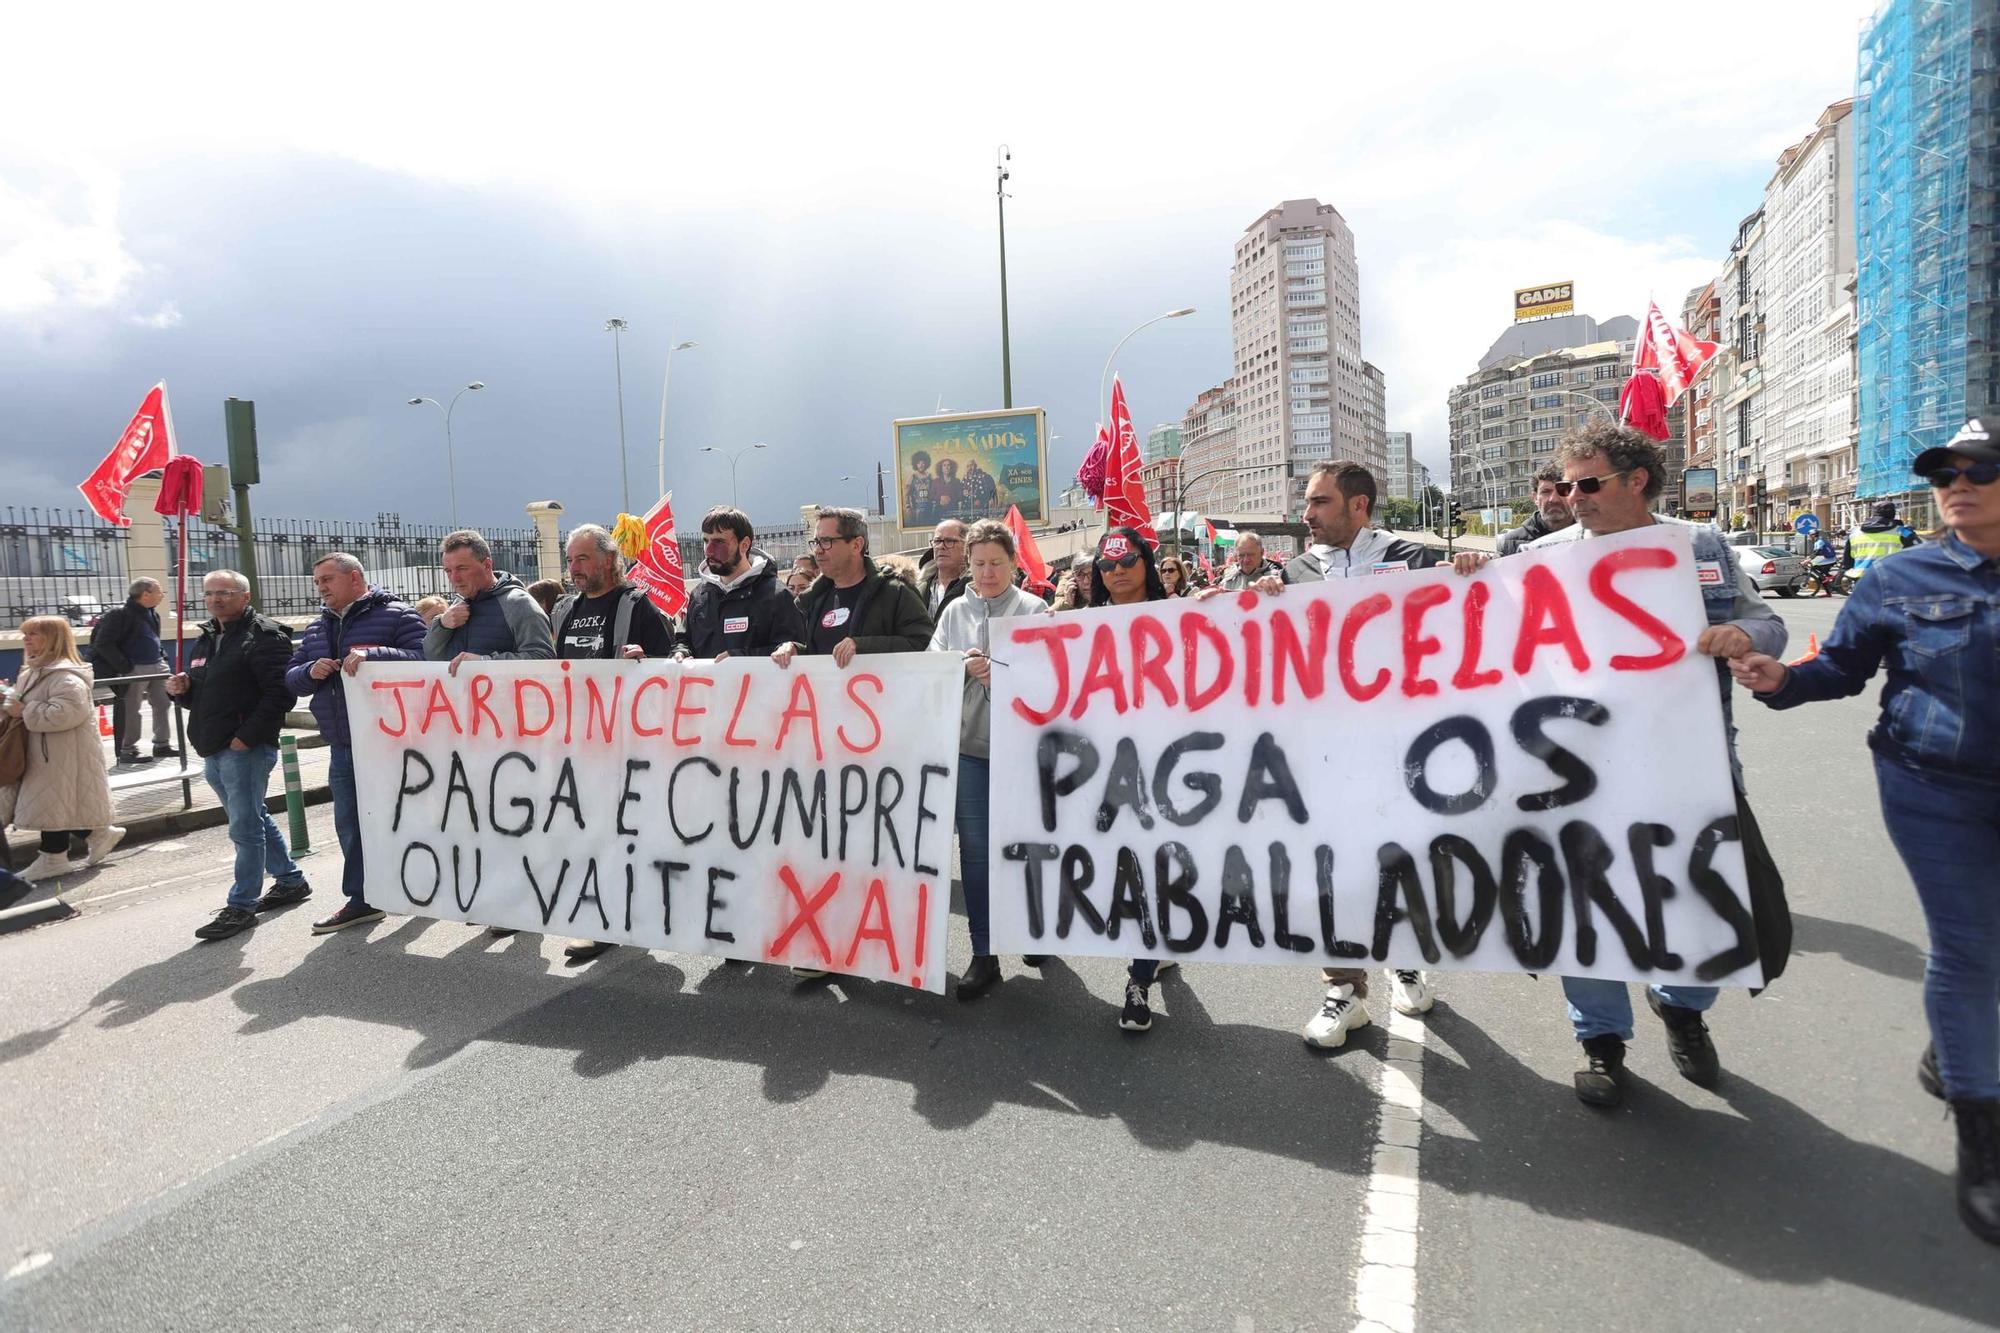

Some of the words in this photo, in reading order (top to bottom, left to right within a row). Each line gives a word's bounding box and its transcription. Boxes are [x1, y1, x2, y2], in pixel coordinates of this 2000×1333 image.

[1519, 286, 1570, 304] GADIS
[1009, 476, 1033, 484] CINES
[1103, 538, 1127, 549] UGT
[392, 748, 586, 837] PAGA
[1037, 730, 1310, 833] PAGA
[1404, 695, 1611, 815] OS
[400, 841, 482, 913] OU
[768, 864, 929, 990] XA!
[1002, 814, 1757, 982] TRABALLADORES
